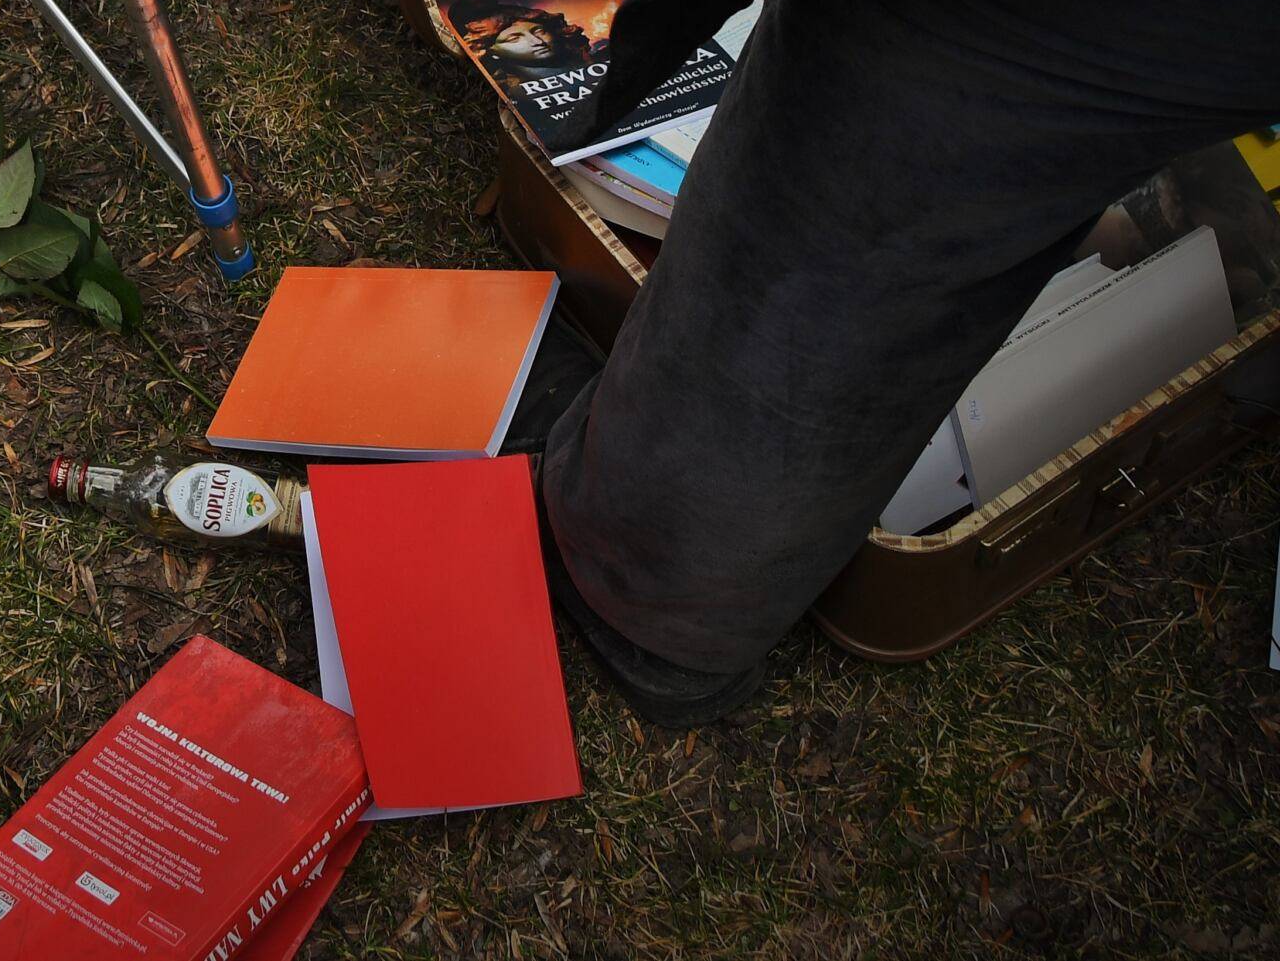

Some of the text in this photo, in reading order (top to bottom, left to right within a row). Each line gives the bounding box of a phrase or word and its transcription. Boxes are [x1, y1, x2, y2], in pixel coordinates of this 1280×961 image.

[520, 59, 611, 96] REWO
[533, 80, 600, 110] FRA
[637, 70, 733, 110] chowieństw
[657, 59, 729, 90] atolickiej
[202, 467, 232, 532] SOPLICA
[224, 481, 238, 522] PIGWOWA
[136, 712, 288, 802] WOJNA KULTUROWA TRWA!
[334, 787, 370, 830] dimir
[291, 830, 331, 876] Palko
[246, 875, 289, 931] LWY
